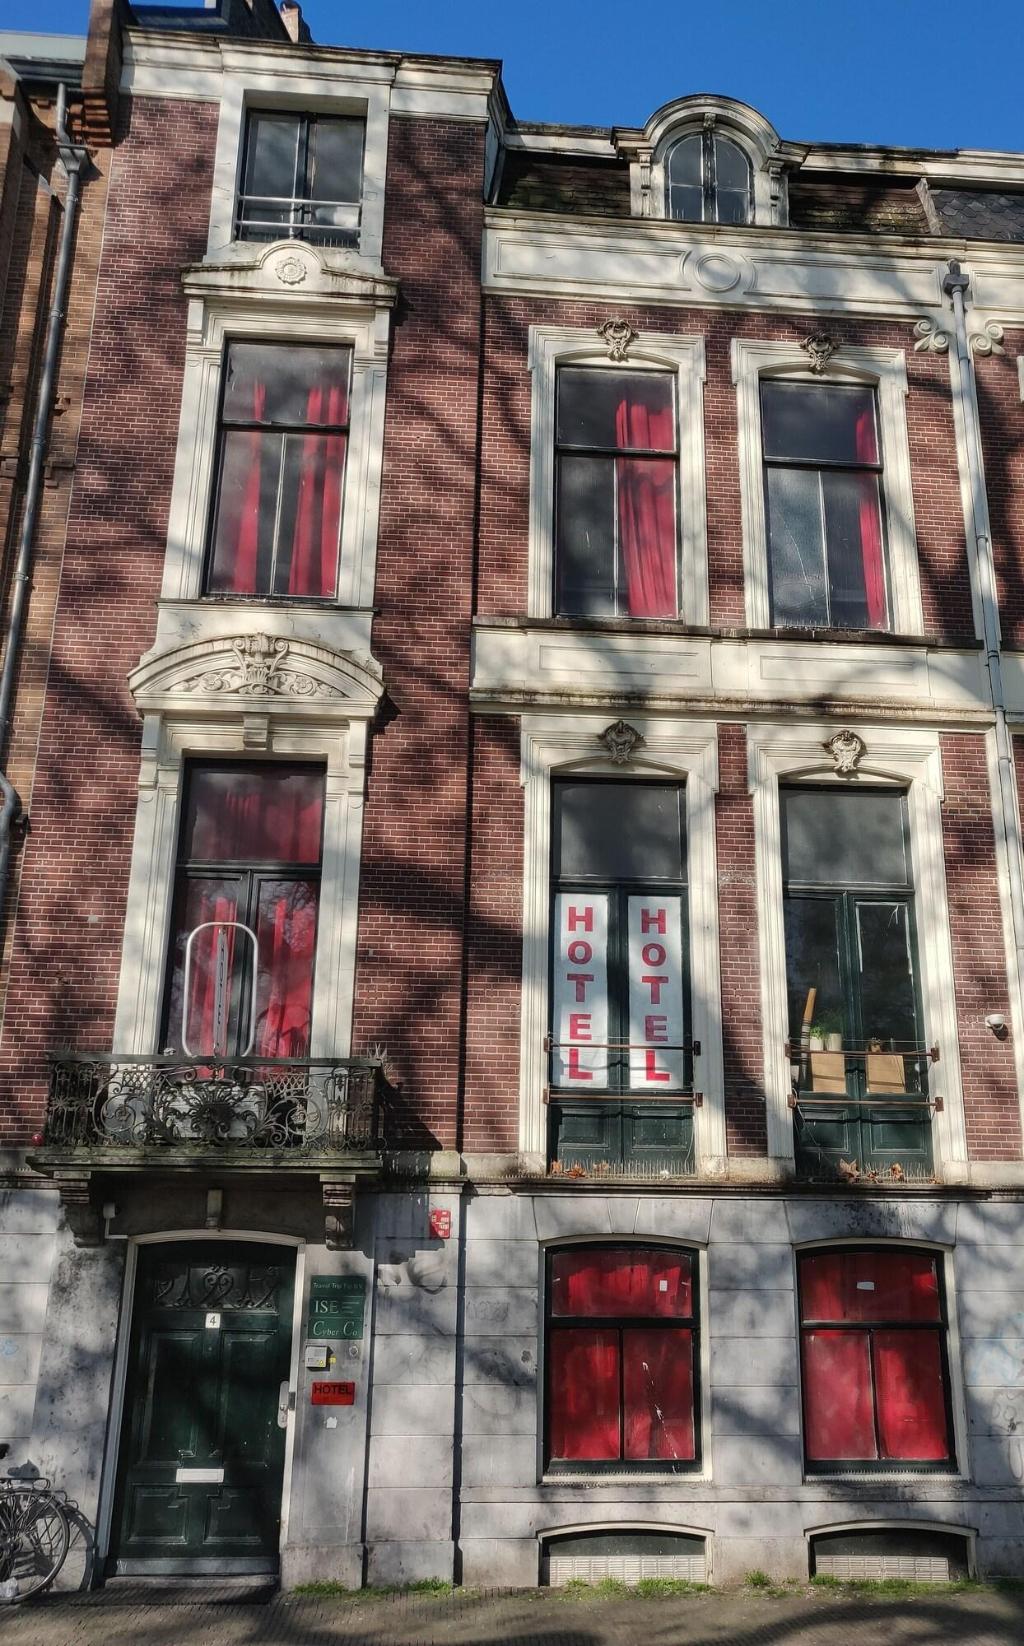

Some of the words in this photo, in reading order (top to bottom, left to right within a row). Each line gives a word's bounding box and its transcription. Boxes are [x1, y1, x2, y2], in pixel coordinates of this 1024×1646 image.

[567, 906, 594, 1080] HOTEL
[641, 908, 671, 1082] HOTEL
[315, 1299, 339, 1314] ISE
[210, 1315, 217, 1326] 4
[314, 1384, 352, 1394] HOTEL
